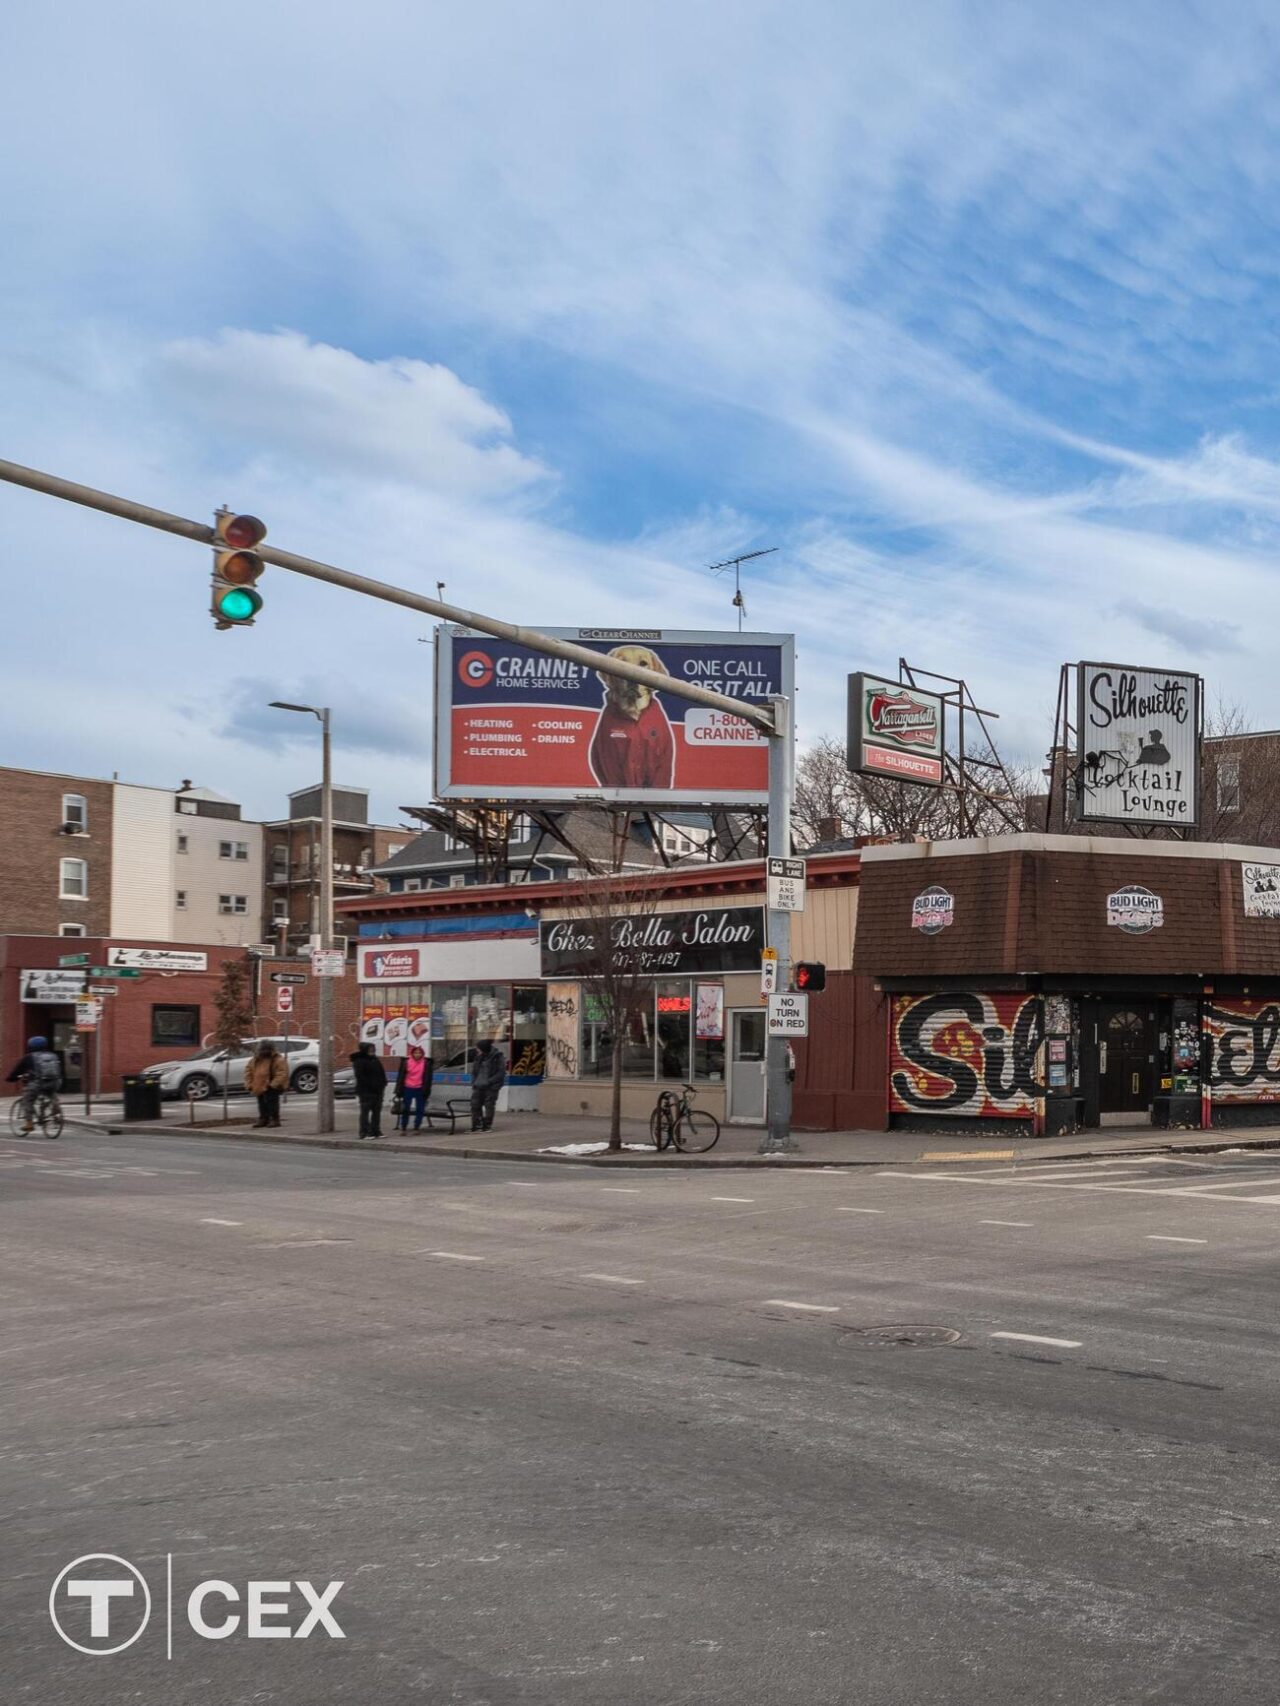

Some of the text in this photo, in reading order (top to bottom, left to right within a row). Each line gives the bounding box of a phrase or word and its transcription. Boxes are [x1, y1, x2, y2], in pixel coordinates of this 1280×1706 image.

[683, 660, 767, 676] ONE CALL
[496, 678, 580, 689] HOME SERVICES
[725, 681, 743, 696] IT
[743, 681, 772, 697] ALL
[1090, 672, 1189, 728] Silhouette
[470, 719, 513, 729] HEATING
[538, 721, 583, 730] COOLING
[470, 733, 522, 743] PLUMBING
[538, 735, 576, 744] DRAINS
[469, 747, 528, 757] ELECTRICAL
[886, 755, 935, 774] SILHOUETTE
[1121, 789, 1188, 818] Lounge
[779, 879, 795, 887] BUS
[778, 893, 795, 901] BIKE
[777, 901, 796, 909] ONLY
[914, 896, 951, 909] BUD LIGHT
[1110, 896, 1159, 909] BUD LIGHT
[548, 912, 755, 951] Chez Bella Salon
[780, 998, 794, 1007] NO
[775, 1008, 800, 1017] TURN
[770, 1018, 805, 1028] ON RED
